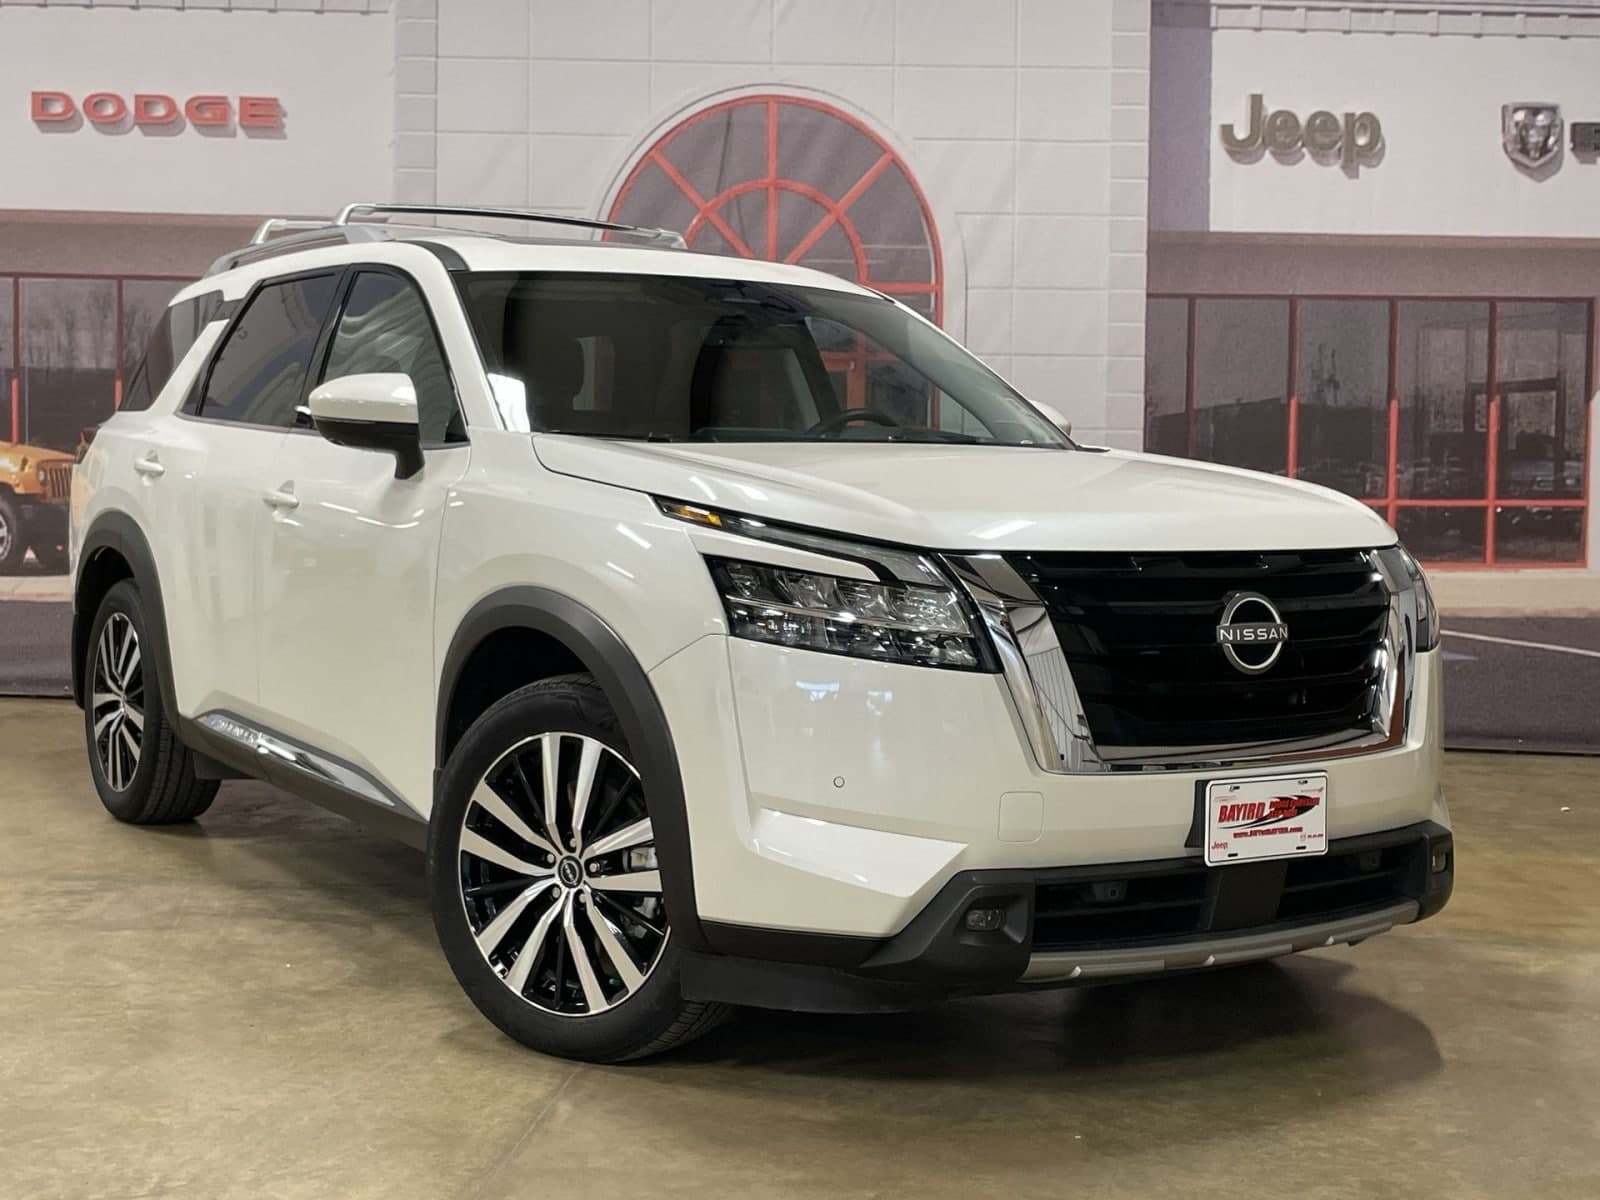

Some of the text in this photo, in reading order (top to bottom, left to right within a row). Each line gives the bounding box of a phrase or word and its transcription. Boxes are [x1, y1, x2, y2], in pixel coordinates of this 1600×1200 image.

[31, 91, 281, 131] DODGE
[1220, 94, 1383, 174] Jeep
[1220, 627, 1288, 641] NISSAN
[1218, 802, 1266, 823] BAYIRD
[1211, 841, 1229, 851] Jeep
